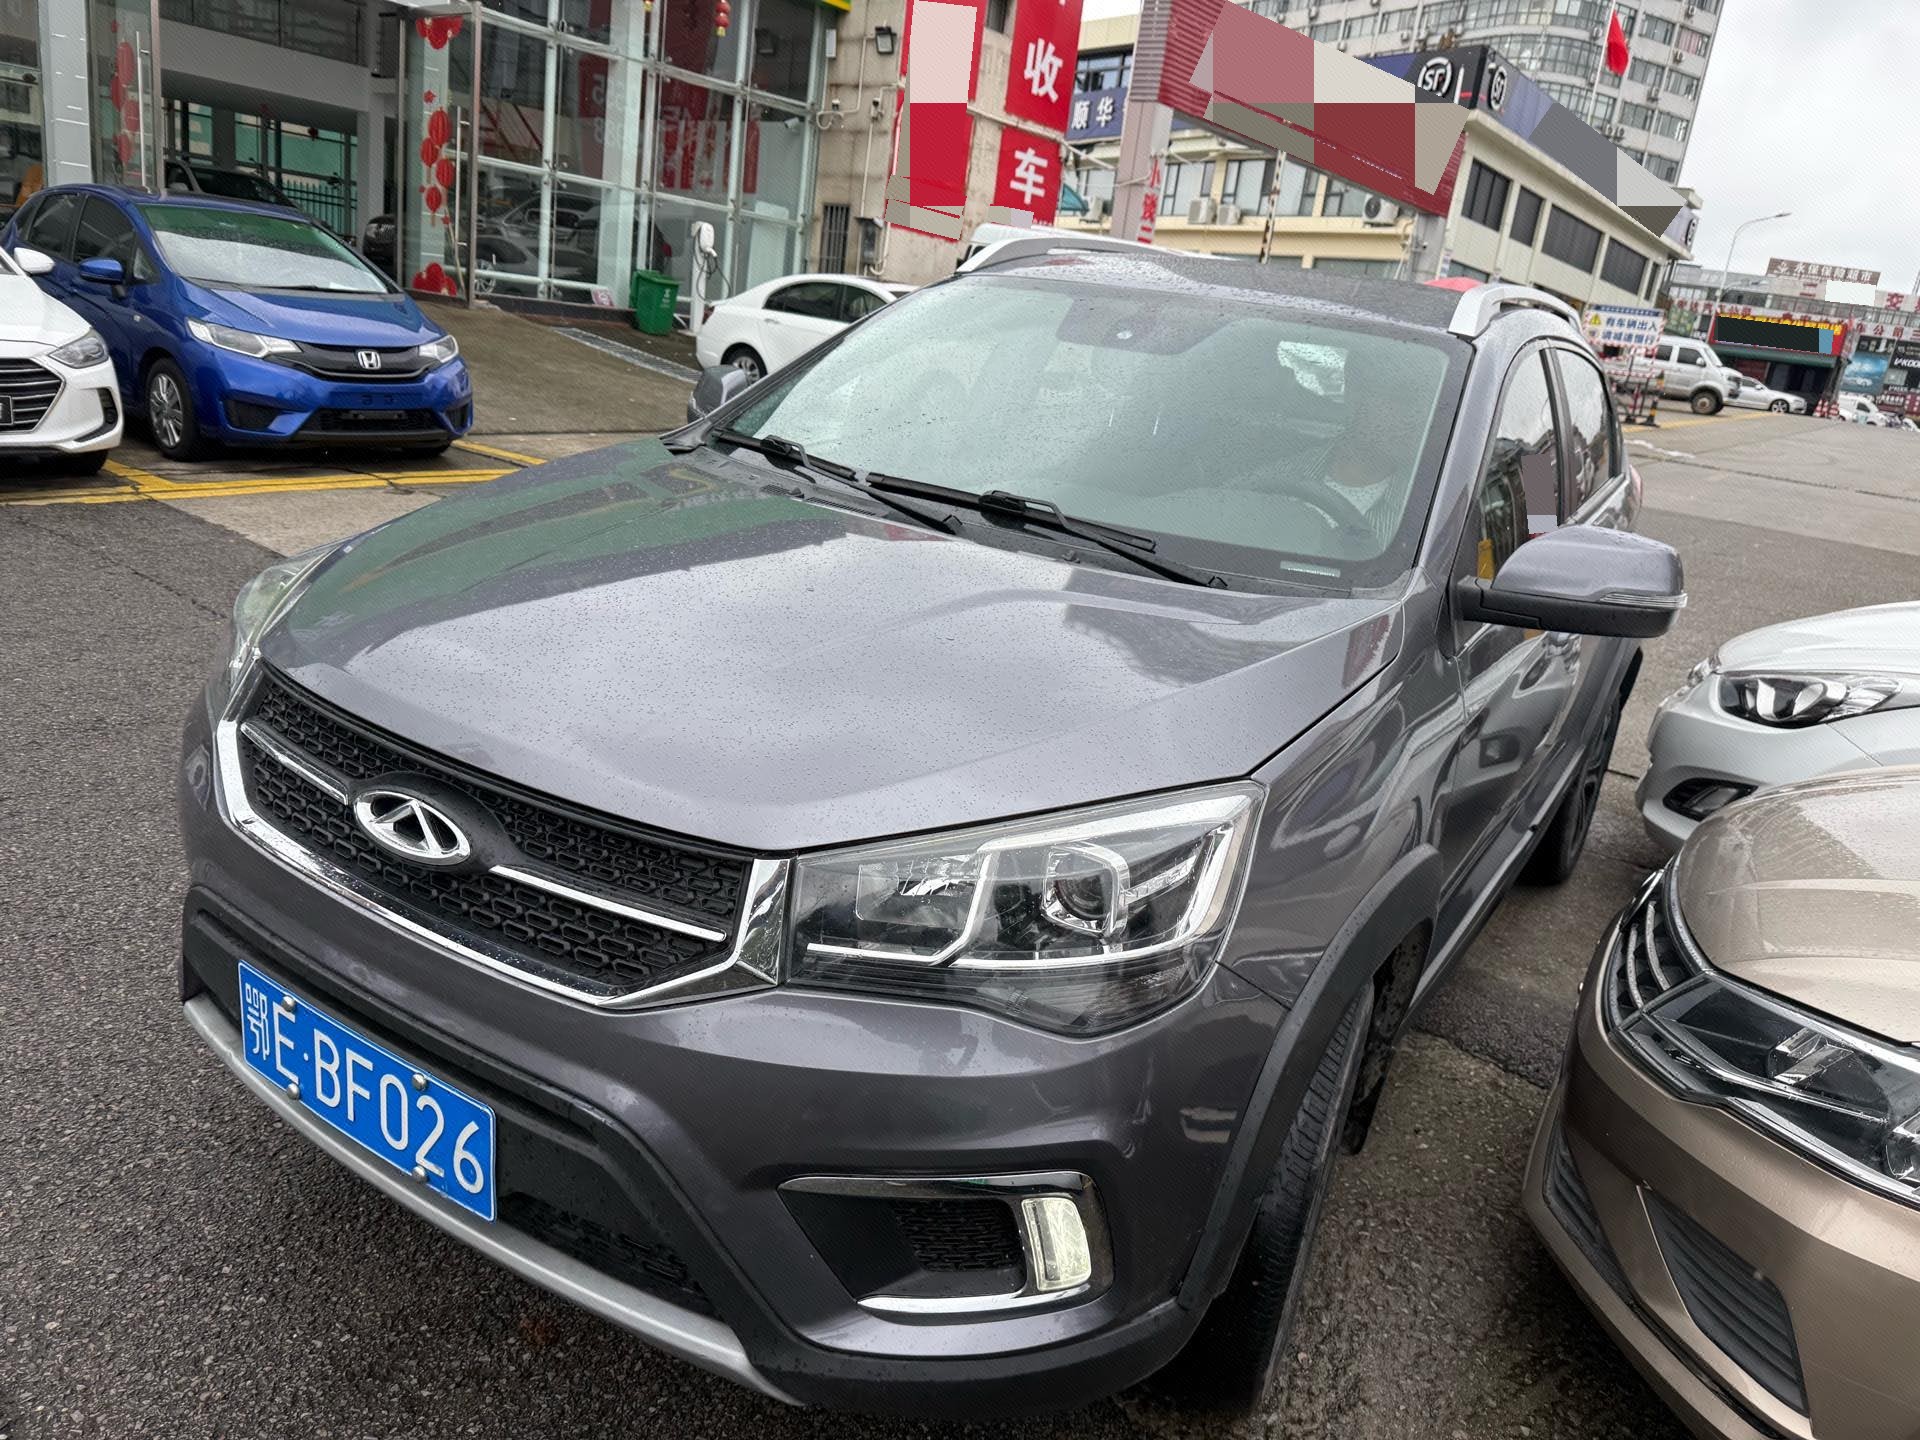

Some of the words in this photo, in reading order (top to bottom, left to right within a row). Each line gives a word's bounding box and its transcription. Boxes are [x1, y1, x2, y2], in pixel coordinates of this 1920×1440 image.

[1071, 95, 1127, 131] 顺华
[1605, 316, 1657, 332] 有车辆出入
